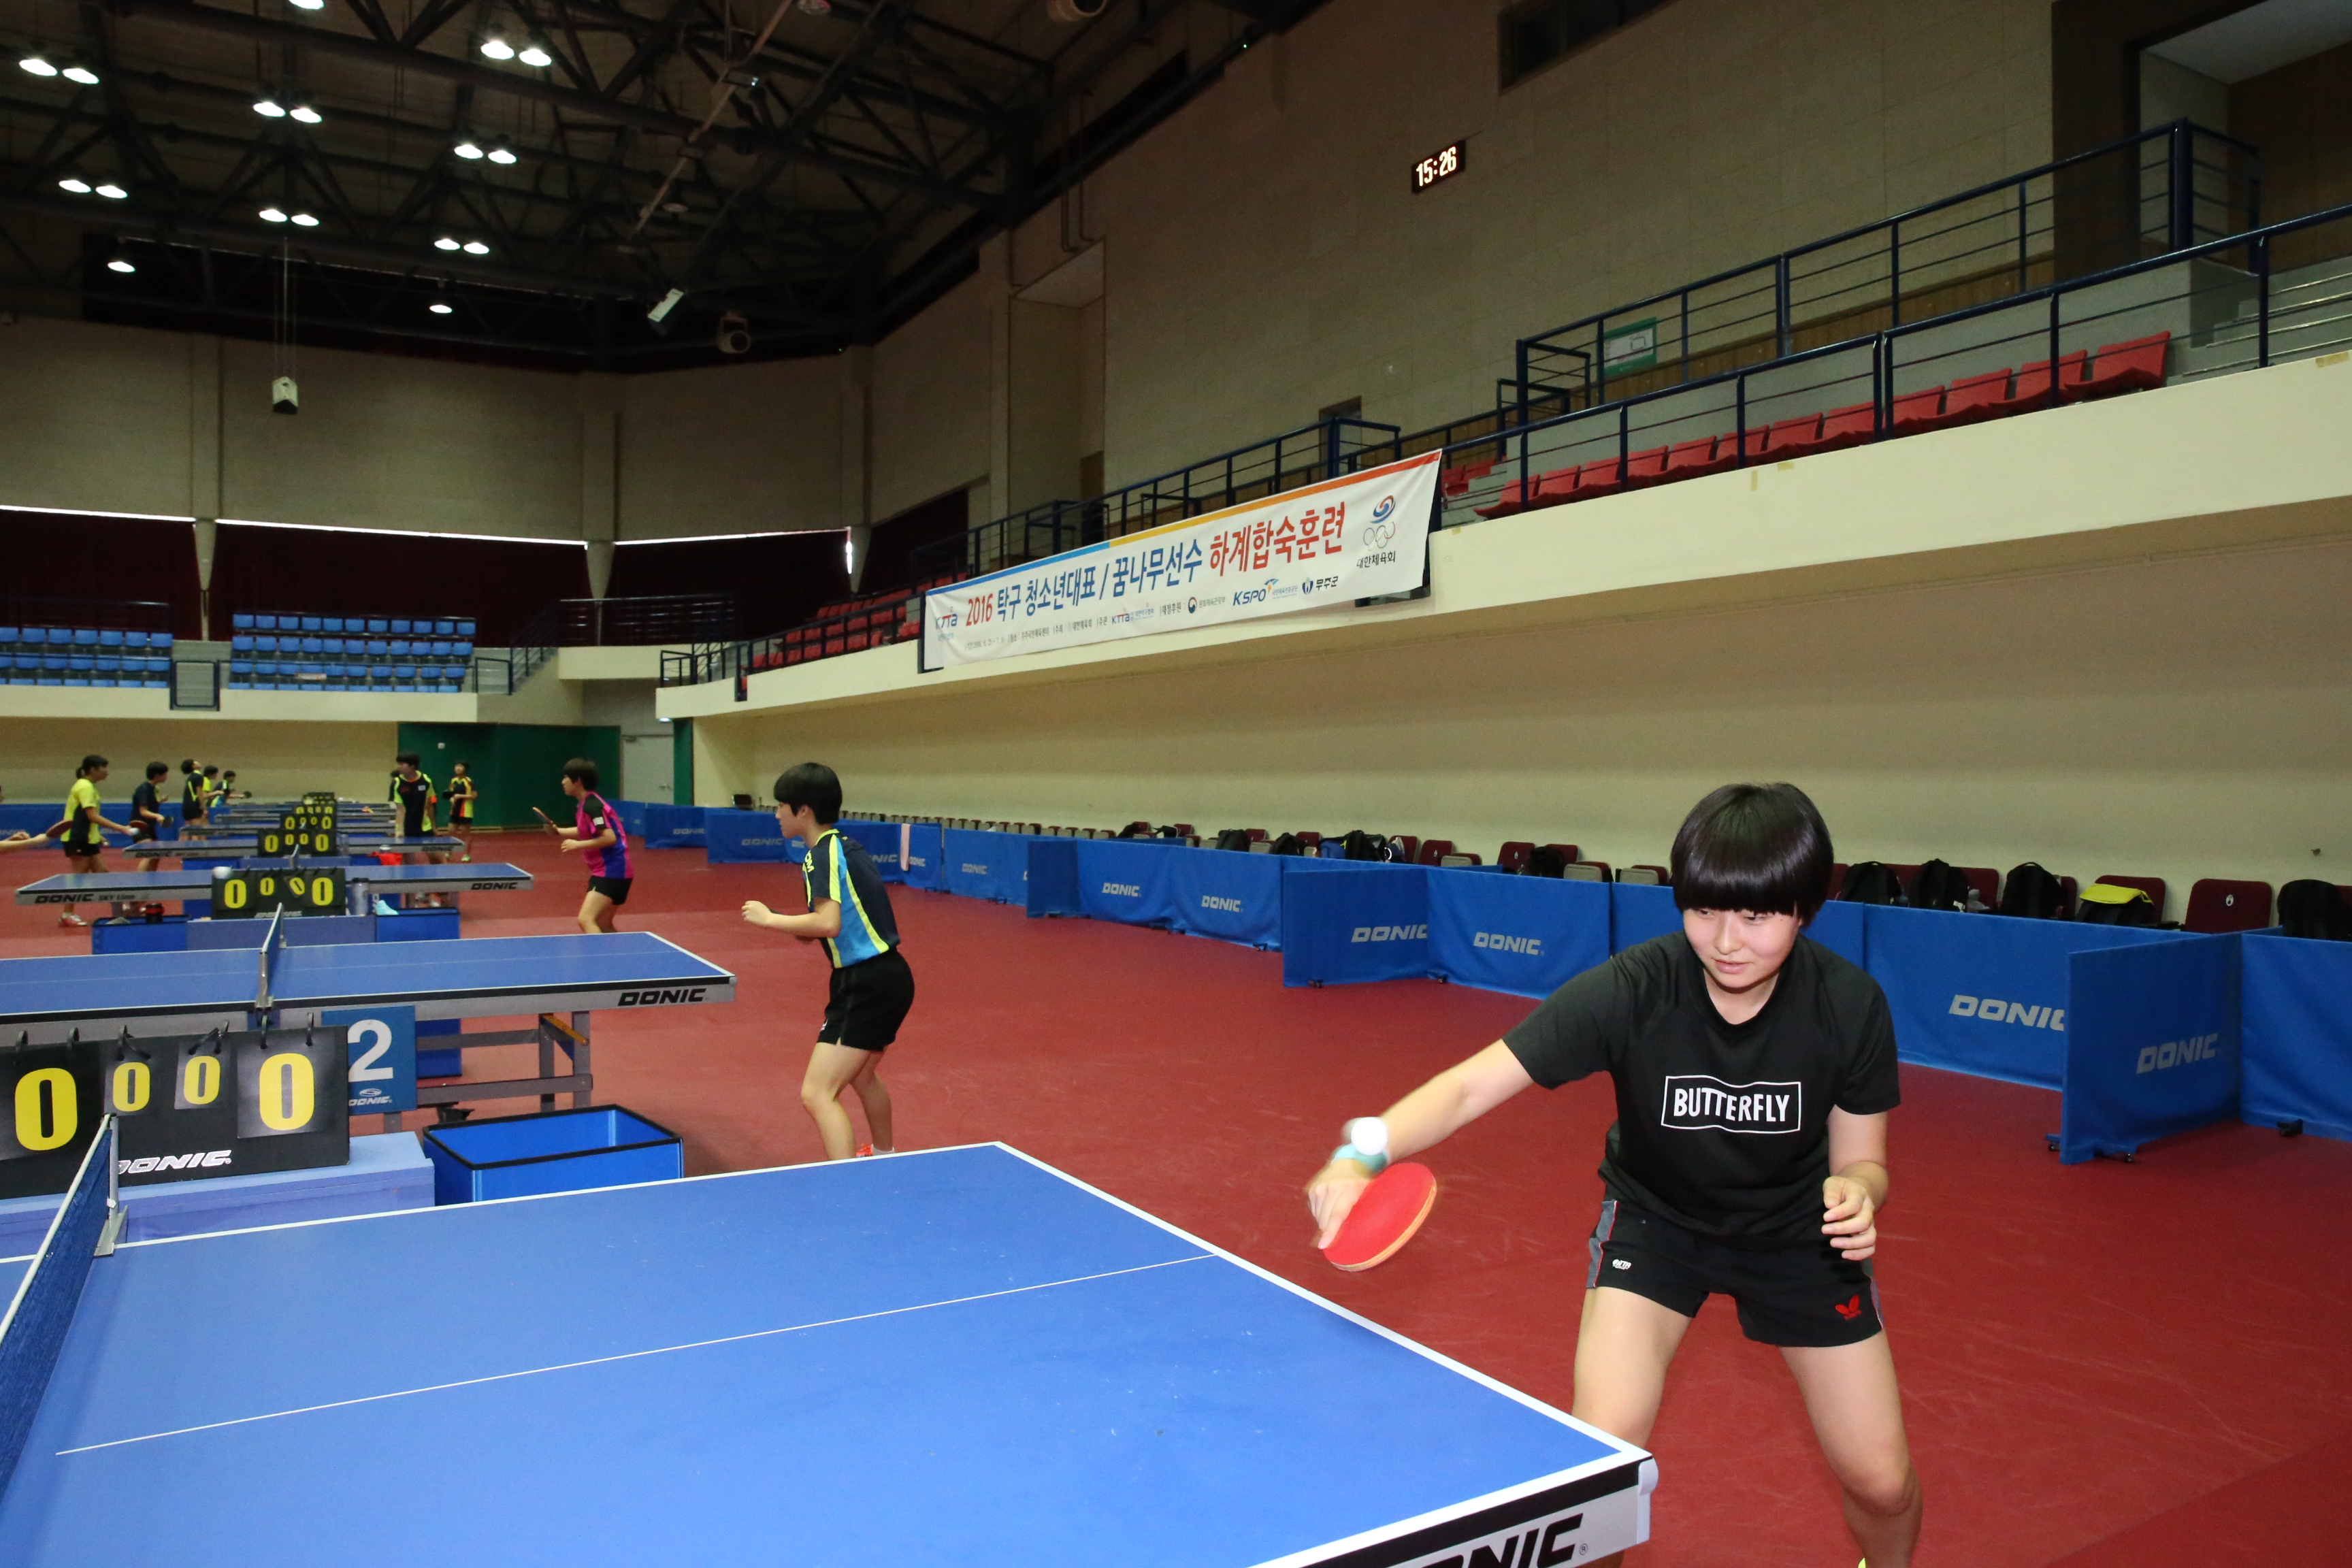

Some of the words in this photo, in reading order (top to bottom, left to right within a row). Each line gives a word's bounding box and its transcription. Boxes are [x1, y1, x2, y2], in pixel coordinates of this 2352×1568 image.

[1416, 146, 1456, 186] 15:26
[965, 593, 994, 627] 2016
[998, 585, 1021, 622] 탁구
[1026, 566, 1096, 617] 청소년대표
[1113, 538, 1203, 598] 꿈나무선수
[1210, 501, 1345, 577] 하계합숙훈련
[1356, 551, 1396, 569] 대한체육회
[1316, 576, 1339, 591] 무주군
[1232, 589, 1267, 606] KSPO
[870, 854, 898, 863] NIC
[225, 879, 246, 909] 0
[260, 877, 274, 896] 0
[312, 877, 333, 906] 0
[470, 882, 518, 891] DONIC
[1102, 882, 1140, 897] DONIC
[35, 894, 93, 904] DONIC
[1201, 895, 1242, 913] DONIC
[1351, 924, 1427, 943] DONIC
[1473, 932, 1541, 956] DONIC
[617, 987, 707, 1007] DONIC
[347, 1019, 394, 1083] 2
[2136, 1032, 2219, 1074] DONIC
[15, 1067, 78, 1151] 0
[112, 1062, 150, 1112] 0
[184, 1056, 220, 1105] 0
[259, 1053, 315, 1131] 0
[1673, 1087, 1790, 1122] BUTTERFLY
